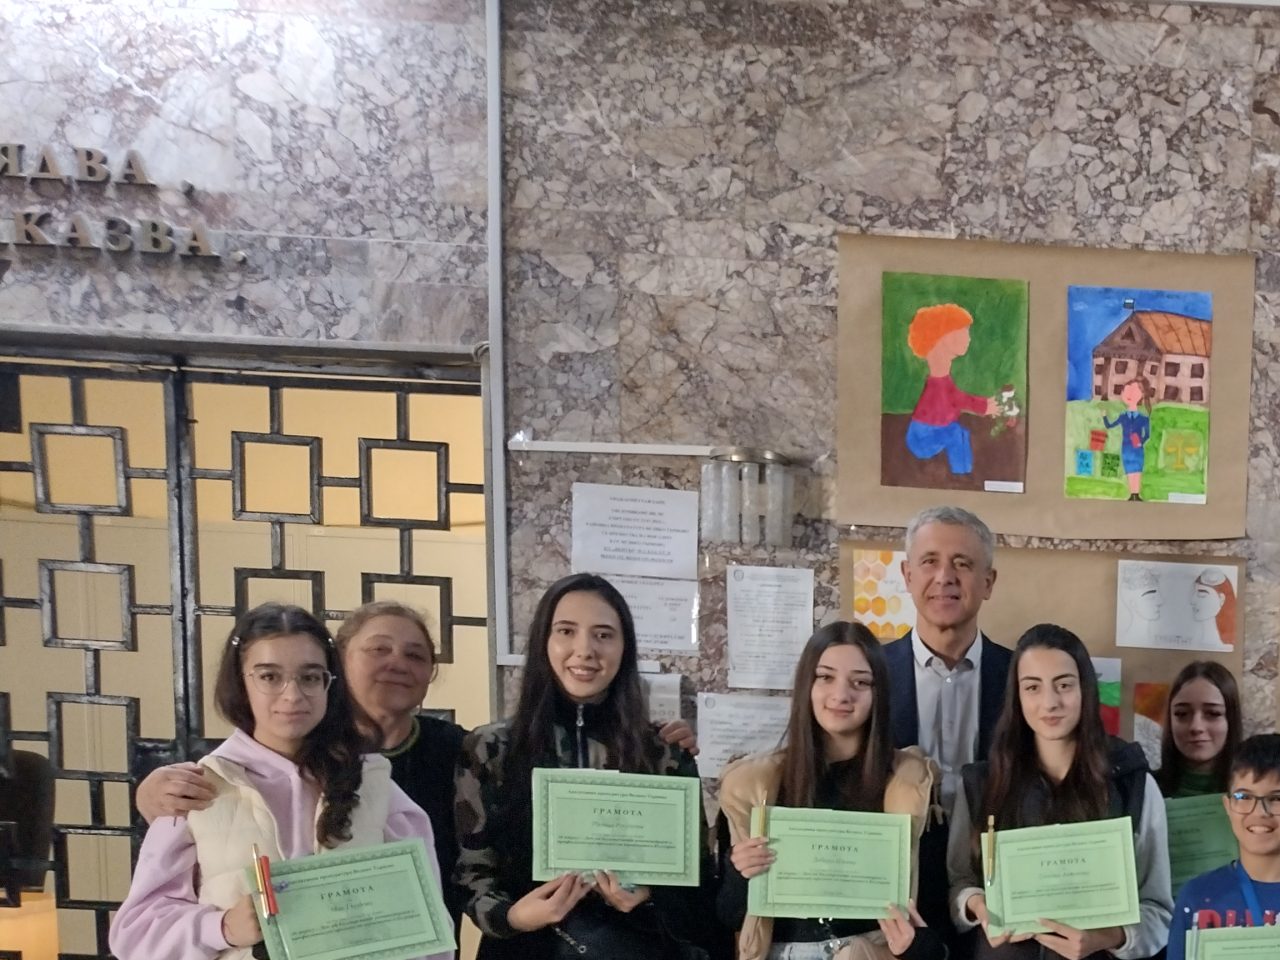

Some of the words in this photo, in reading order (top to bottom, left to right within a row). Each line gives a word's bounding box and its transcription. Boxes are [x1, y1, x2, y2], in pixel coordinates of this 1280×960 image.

[593, 808, 643, 816] ГРАМОТА
[812, 844, 859, 853] ГРАМОТА
[1040, 857, 1087, 867] ГРАМОТА
[320, 885, 375, 900] ГРАМОТА
